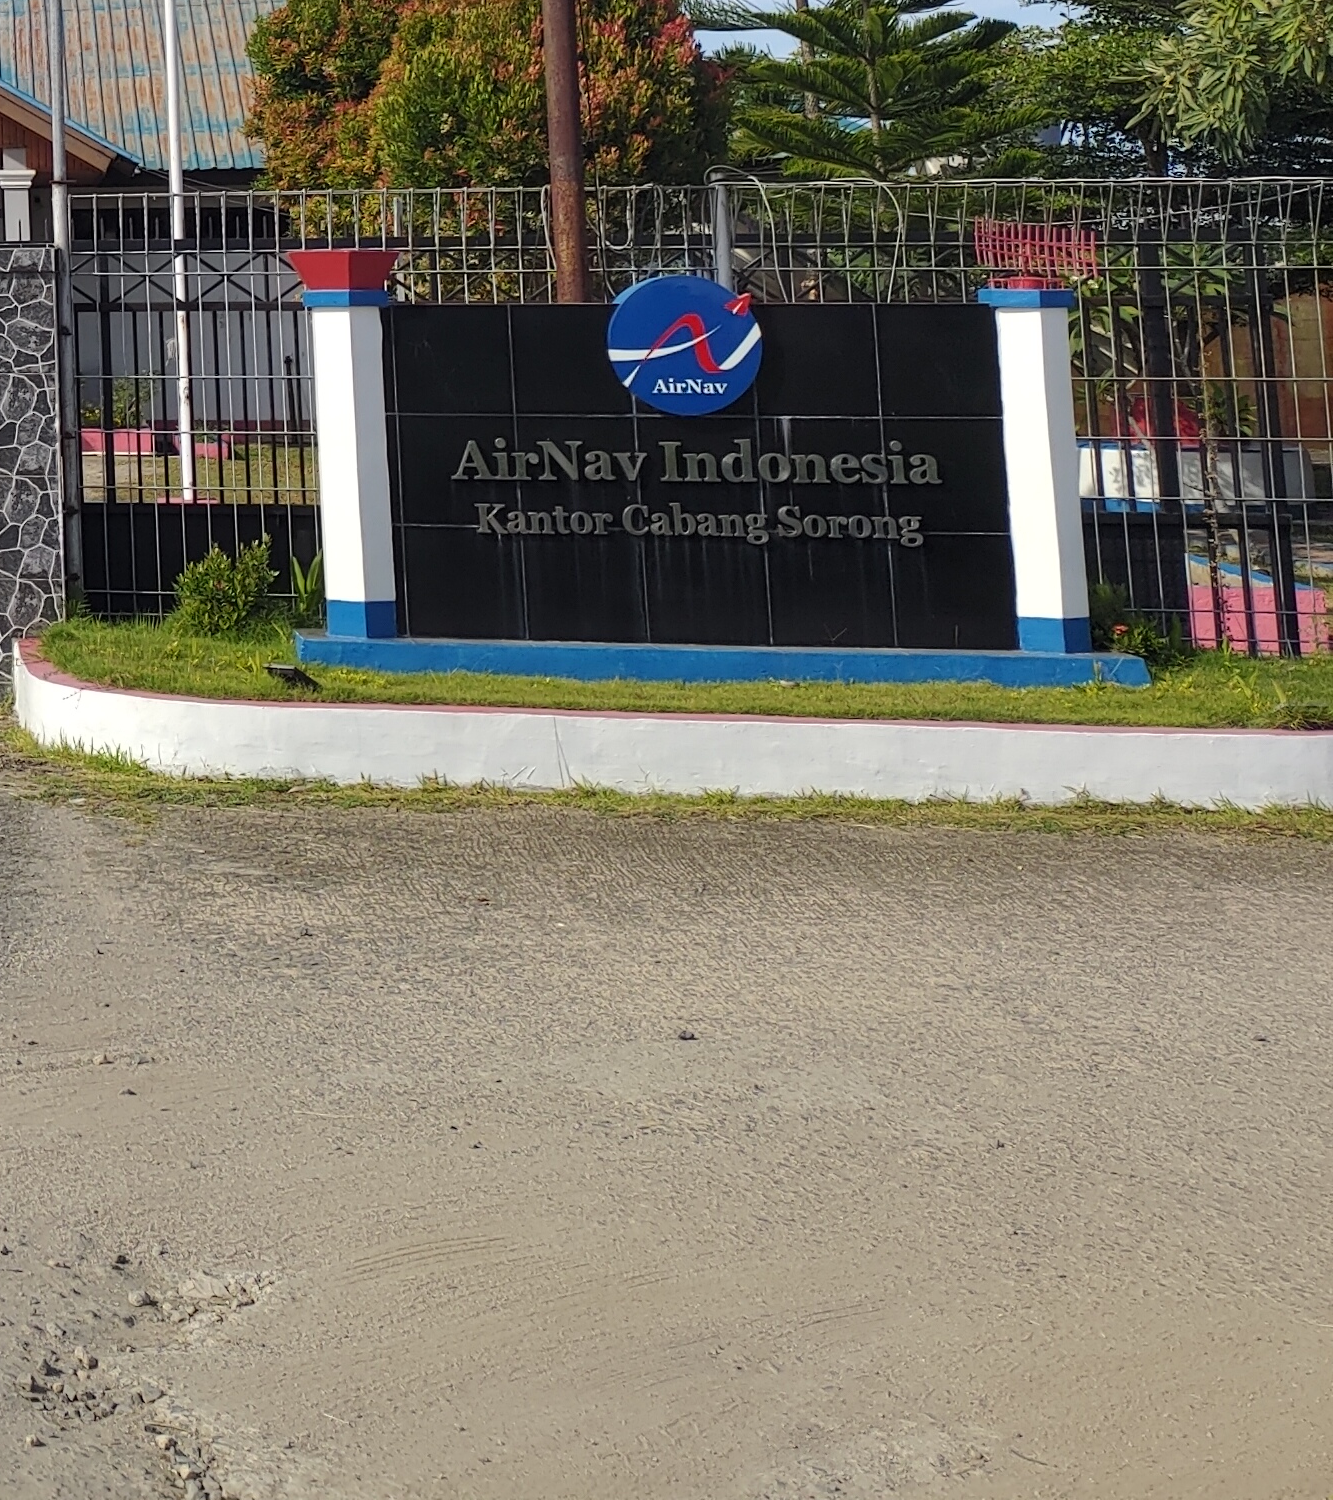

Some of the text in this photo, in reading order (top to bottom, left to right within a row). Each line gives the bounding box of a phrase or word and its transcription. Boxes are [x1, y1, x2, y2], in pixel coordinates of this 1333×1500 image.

[651, 377, 728, 394] AirNav
[450, 437, 943, 485] AirNav Indonesia
[473, 502, 925, 548] Kantor Cabang Sorong
